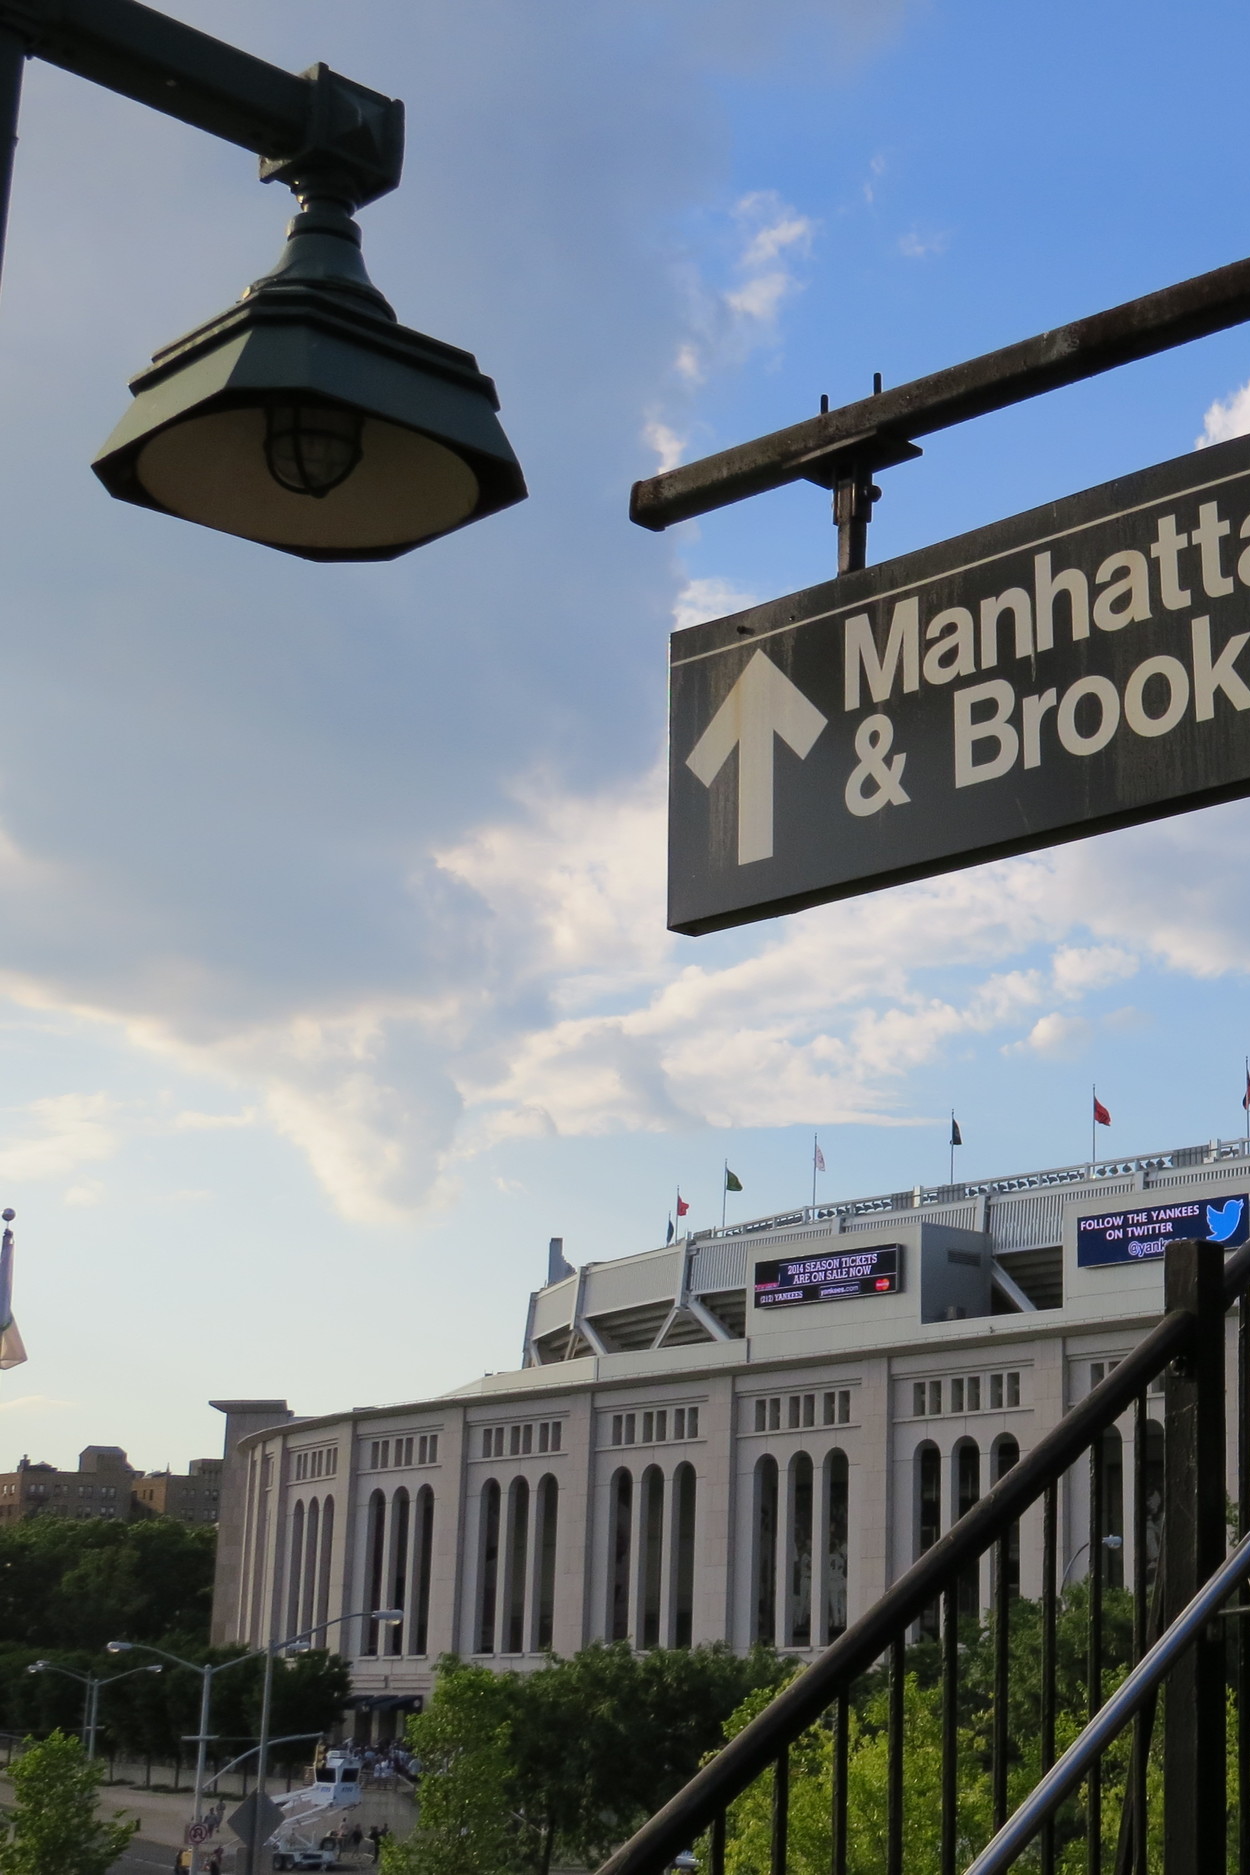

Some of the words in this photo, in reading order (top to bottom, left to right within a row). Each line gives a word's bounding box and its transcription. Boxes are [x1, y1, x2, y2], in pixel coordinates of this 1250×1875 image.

[845, 714, 911, 816] &
[1080, 1216, 1124, 1231] FOLLOW
[1127, 1212, 1148, 1225] THE
[1151, 1205, 1200, 1221] YANKEES
[1106, 1229, 1123, 1241] ON
[1127, 1222, 1174, 1237] TWITTER
[1128, 1237, 1187, 1257] @yank
[787, 1264, 804, 1275] 2014
[805, 1259, 840, 1272] SEASON
[841, 1254, 878, 1267] TICKETS
[793, 1274, 810, 1285] ARE
[811, 1271, 825, 1282] ON
[826, 1268, 848, 1280] SALE
[849, 1265, 872, 1277] NOW
[774, 1290, 803, 1301] YANKEES
